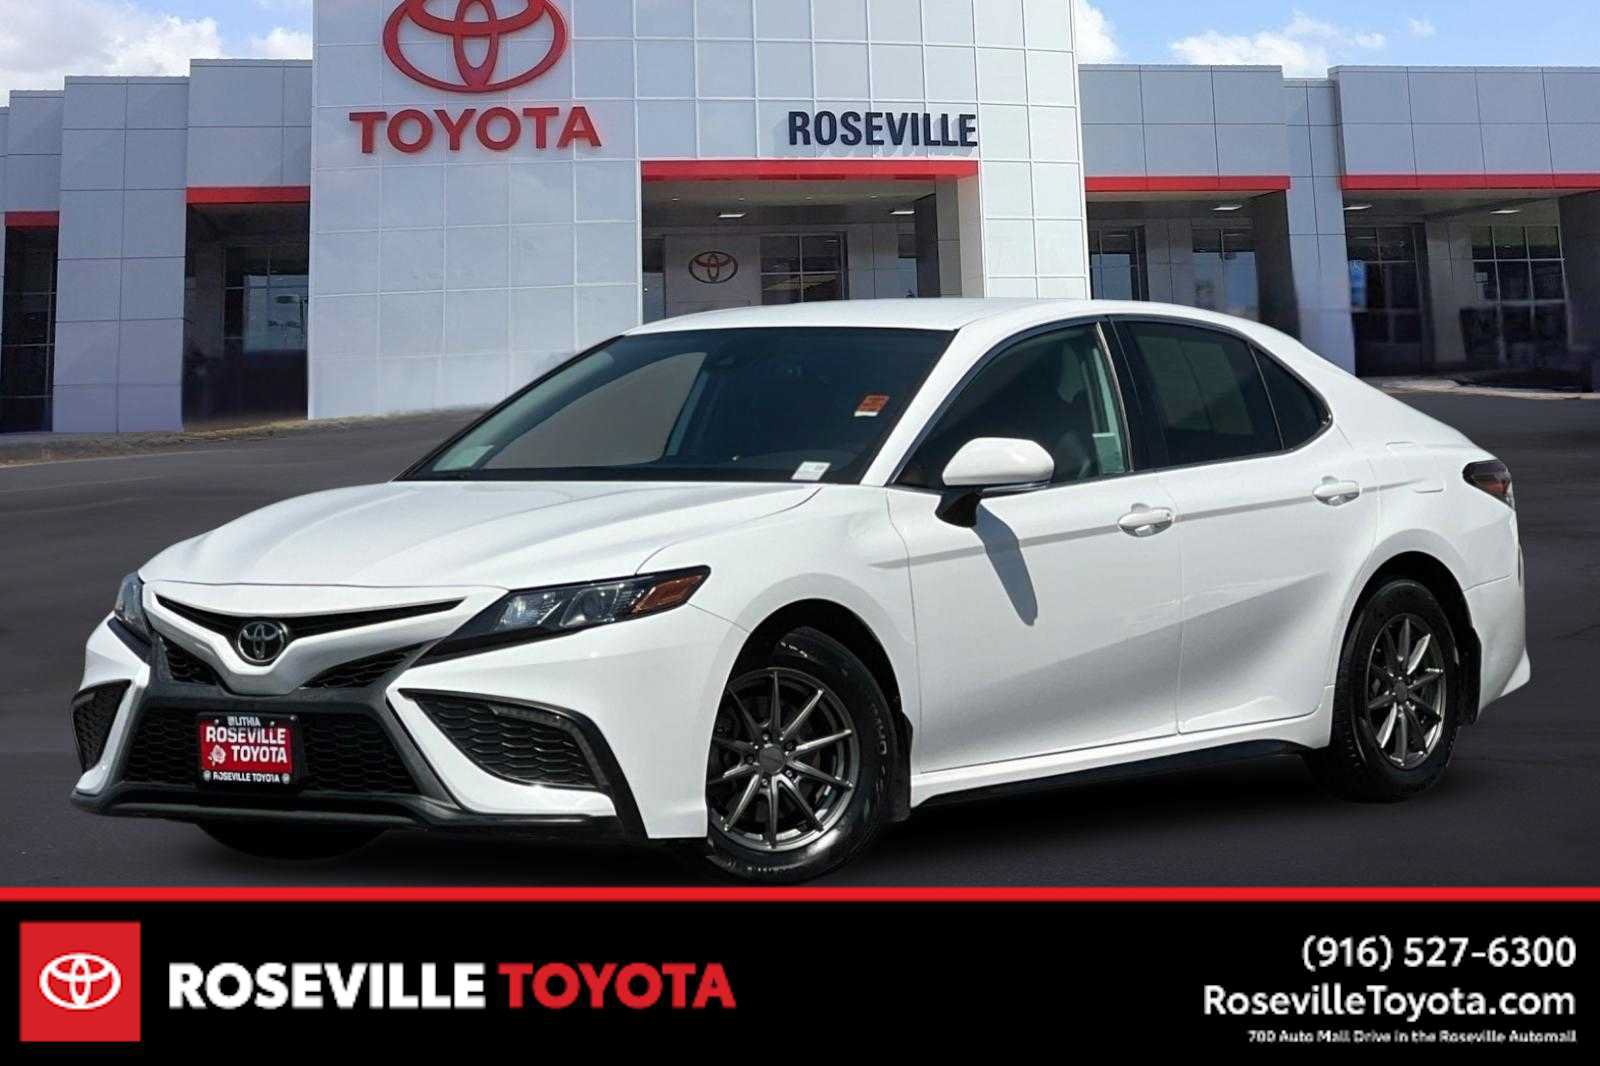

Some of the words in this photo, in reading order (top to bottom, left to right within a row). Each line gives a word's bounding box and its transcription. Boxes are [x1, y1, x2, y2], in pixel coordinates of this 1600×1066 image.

[349, 106, 602, 154] TOYOTA
[788, 110, 979, 147] ROSEVILLE
[206, 726, 286, 744] ROSEVILLE
[231, 745, 287, 763] TOYOTA
[213, 771, 251, 781] ROSEVILLE
[252, 773, 280, 783] TOYOTA
